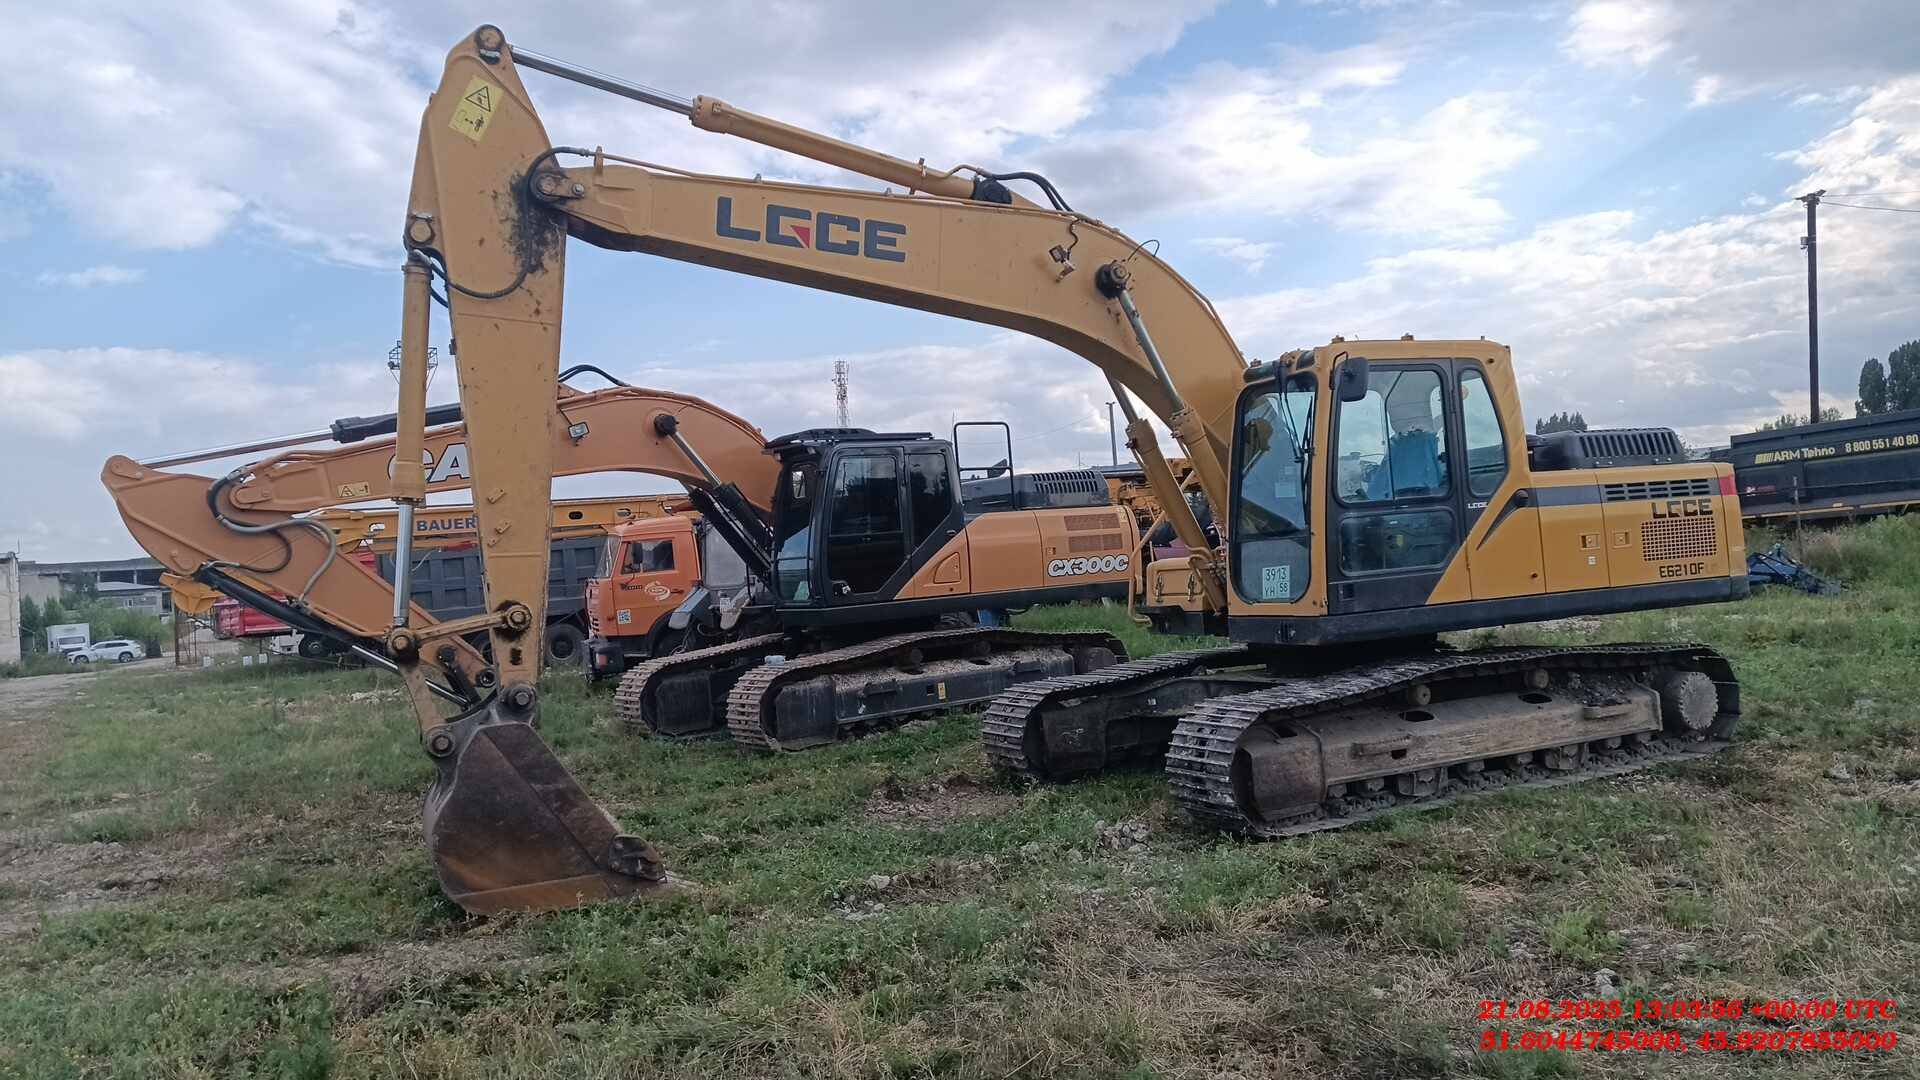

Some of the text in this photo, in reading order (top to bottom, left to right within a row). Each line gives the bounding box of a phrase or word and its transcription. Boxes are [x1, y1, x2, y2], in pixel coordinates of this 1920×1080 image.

[1774, 449, 1800, 462] ARM
[1845, 442, 1852, 453] 8
[1853, 440, 1871, 452] 800
[1872, 438, 1889, 450] 551
[1892, 435, 1905, 447] 40
[416, 517, 477, 532] BAUER
[1048, 554, 1129, 577] CX300C
